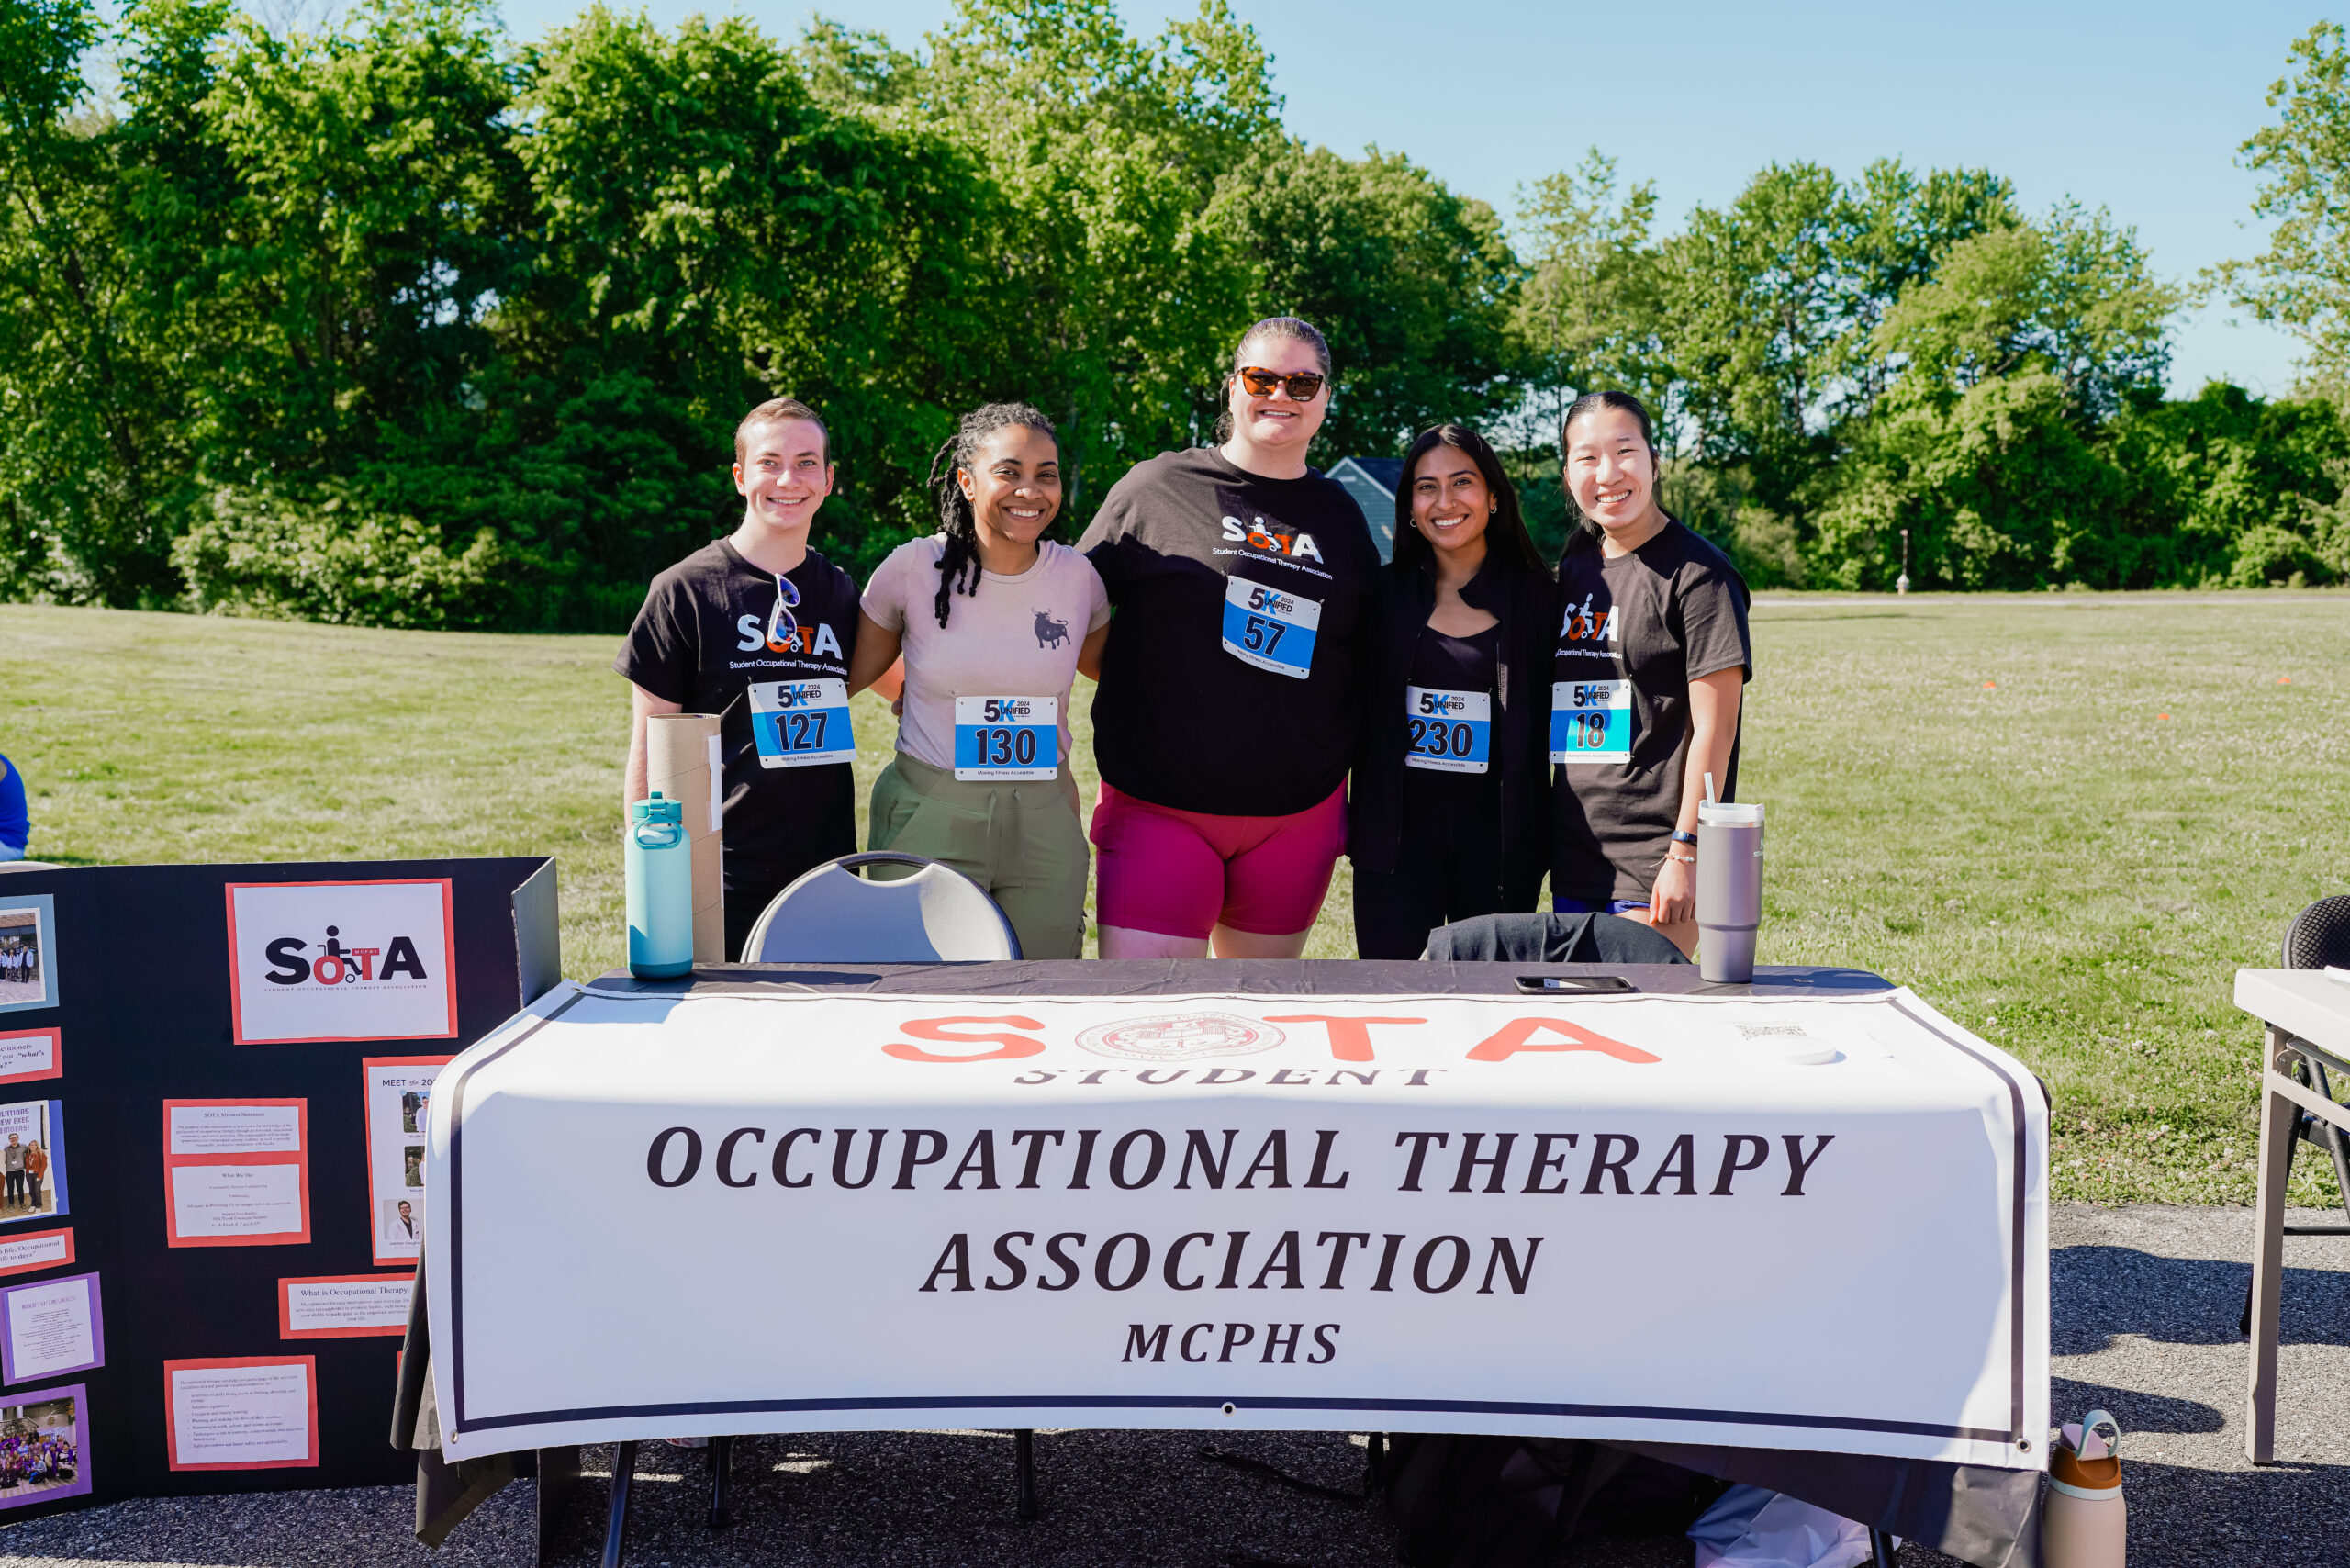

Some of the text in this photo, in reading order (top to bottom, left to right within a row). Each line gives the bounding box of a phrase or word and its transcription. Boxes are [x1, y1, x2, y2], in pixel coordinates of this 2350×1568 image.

[1222, 516, 1324, 564] SOTA
[1212, 547, 1333, 580] Student Occupational Therapy Association
[1248, 587, 1281, 615] 5K
[1264, 598, 1292, 612] UNIFIED
[1281, 597, 1294, 605] 2024
[1560, 602, 1619, 642] SOTA
[1243, 613, 1287, 656] 57
[729, 658, 847, 675] Student Occupational Therapy Association
[778, 683, 808, 708] 5K
[792, 689, 822, 700] UNIFIED
[1419, 692, 1450, 715] 5K
[1435, 700, 1465, 710] UNIFIED
[1573, 685, 1597, 707] 5K
[1585, 691, 1610, 700] UNIFIED
[983, 700, 1016, 722] 5K
[1000, 707, 1031, 715] UNIFIED
[775, 711, 828, 751] 127
[1409, 719, 1473, 758] 230
[1576, 712, 1605, 748] 18
[975, 728, 1036, 766] 130
[264, 936, 428, 985] SOTA
[421, 1078, 437, 1086] 20
[1013, 1068, 1448, 1086] STUDENT
[14, 1116, 29, 1125] EXEC
[646, 1126, 1836, 1196] OCCUPATIONAL THERAPY
[18, 1240, 60, 1251] Occupational
[918, 1230, 1545, 1295] ASSOCIATION
[330, 1287, 376, 1297] Occupational
[1121, 1321, 1341, 1365] MCPHS
